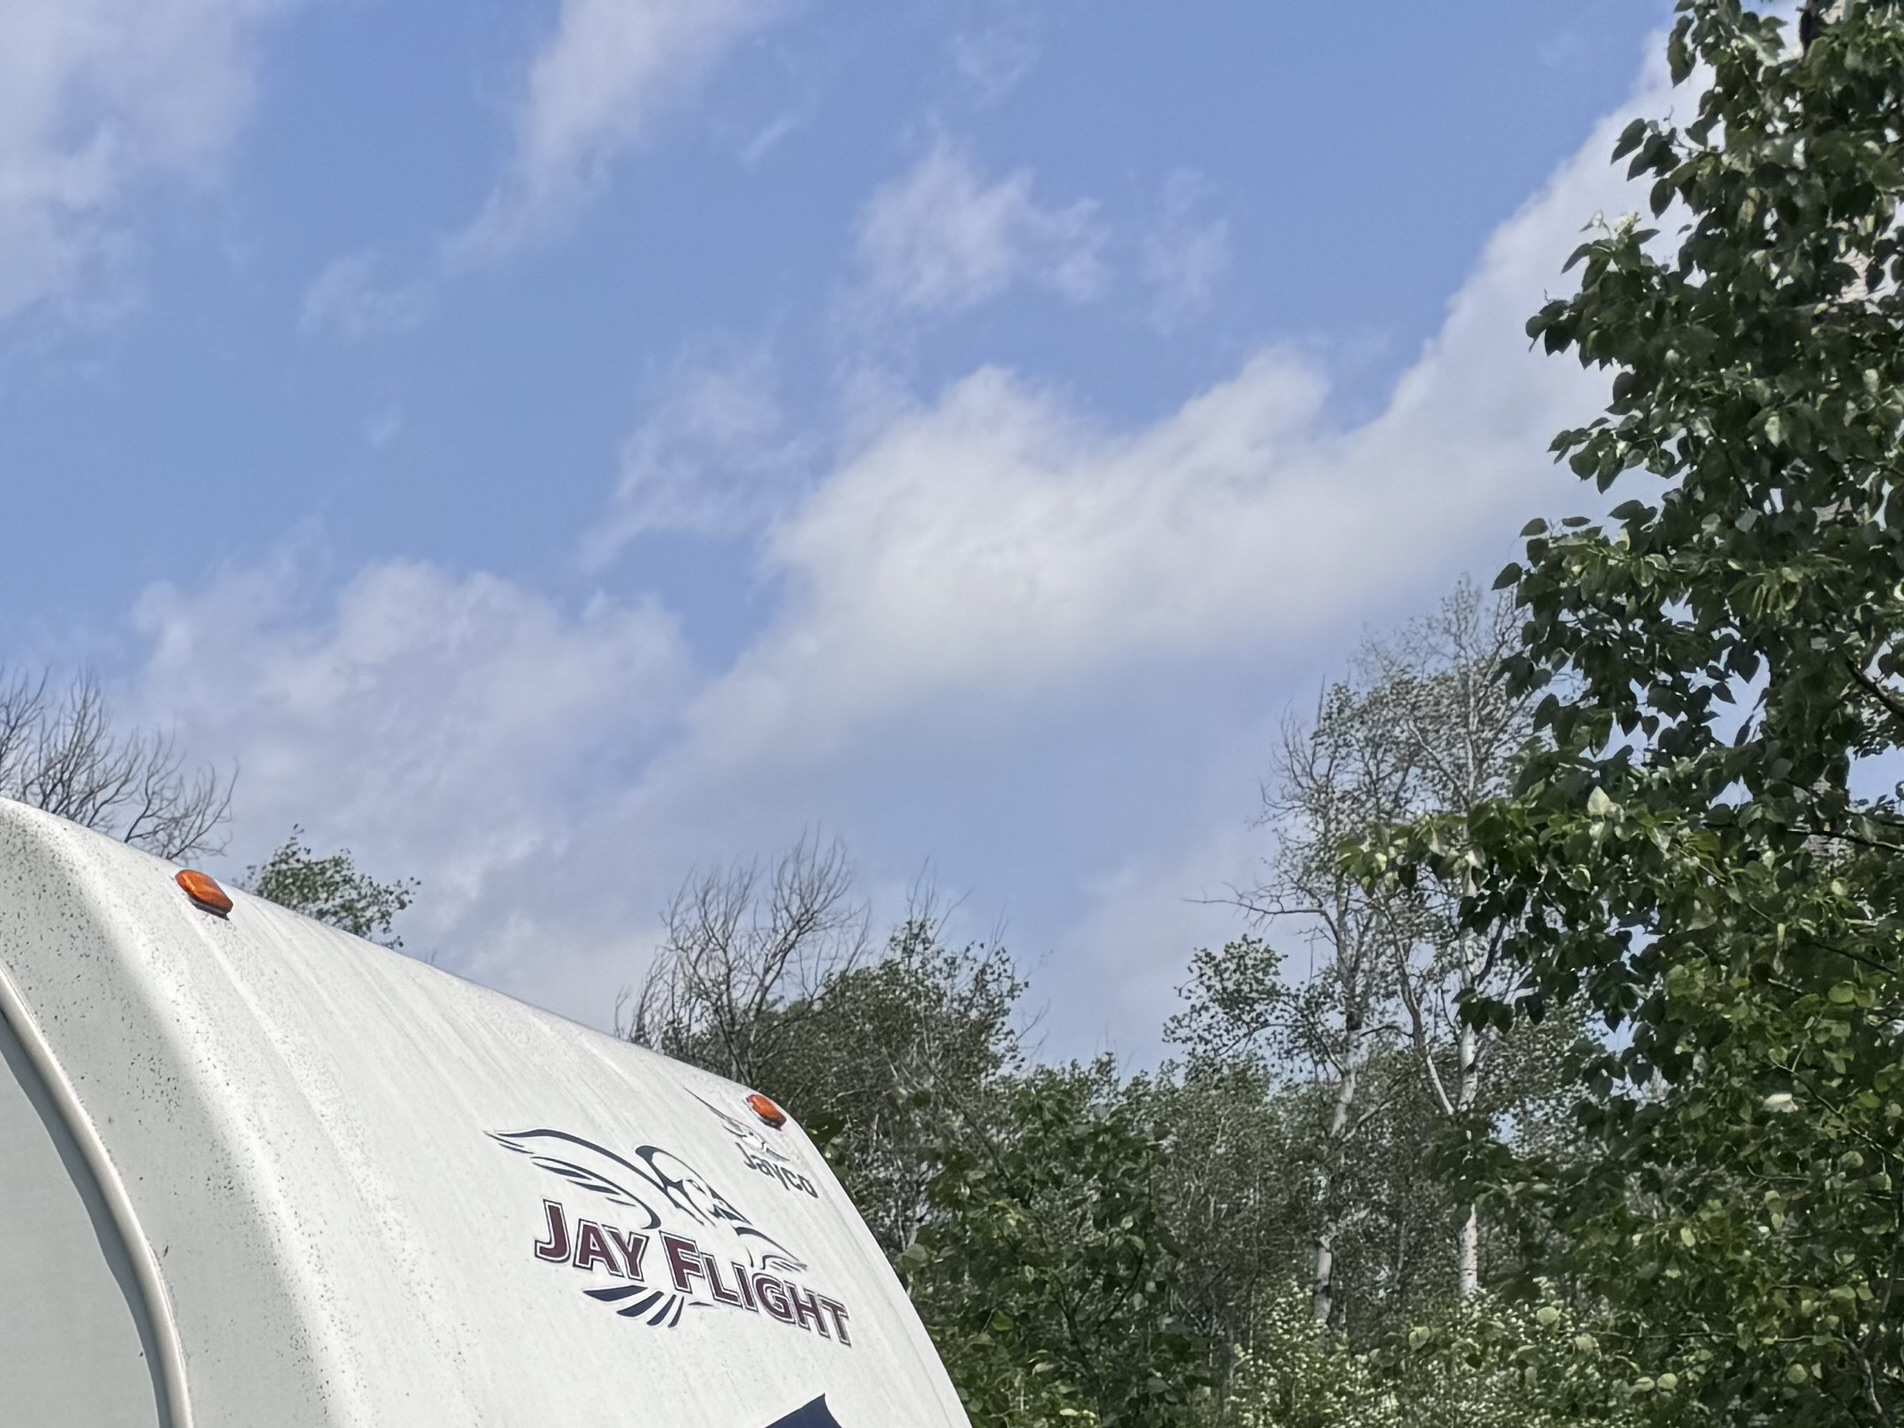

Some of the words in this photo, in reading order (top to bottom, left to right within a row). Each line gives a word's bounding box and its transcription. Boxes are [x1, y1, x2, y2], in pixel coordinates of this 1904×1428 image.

[735, 1142, 819, 1199] Jayco
[534, 1198, 649, 1282] JAY
[658, 1229, 852, 1348] FLIGHT
